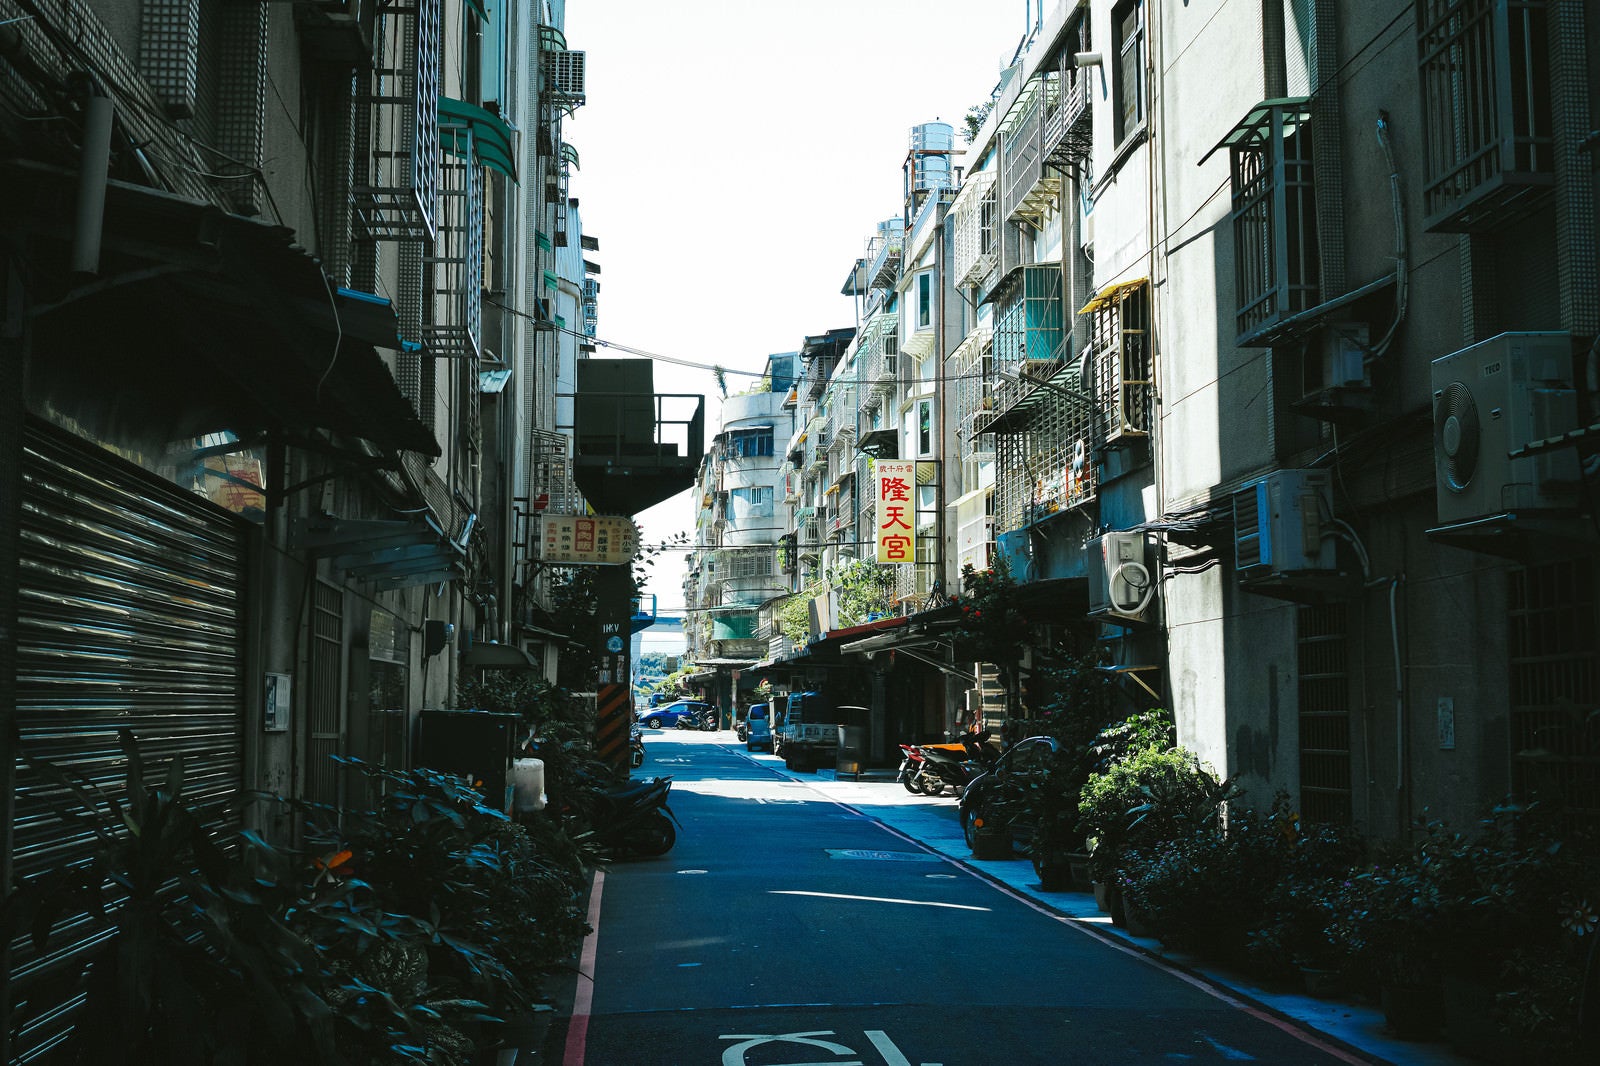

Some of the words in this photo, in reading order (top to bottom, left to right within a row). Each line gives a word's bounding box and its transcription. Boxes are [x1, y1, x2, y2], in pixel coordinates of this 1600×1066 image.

[1485, 362, 1501, 375] TECO
[881, 477, 912, 559] 隆天宮
